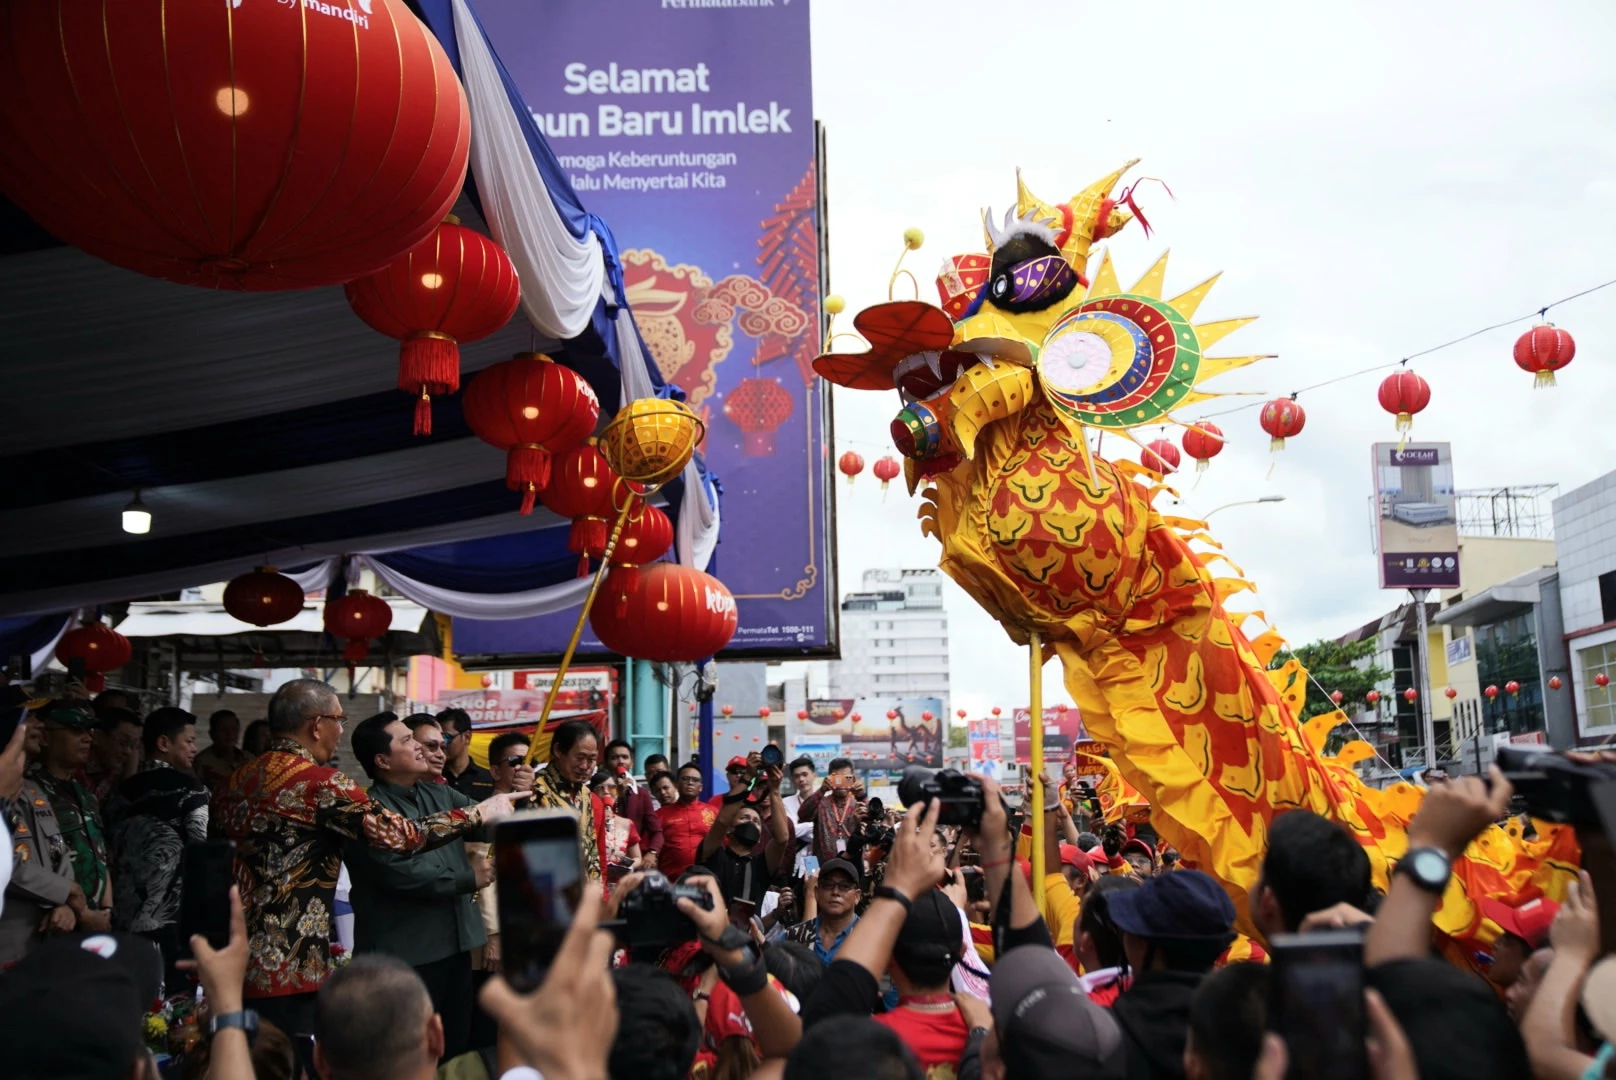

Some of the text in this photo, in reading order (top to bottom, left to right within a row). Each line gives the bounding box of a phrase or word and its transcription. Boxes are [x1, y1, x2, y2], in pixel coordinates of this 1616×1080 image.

[303, 0, 370, 30] mandiri
[563, 62, 710, 95] Selamat
[598, 103, 684, 137] Baru
[691, 101, 793, 136] Imlek
[556, 150, 737, 171] moga Keberuntungan
[602, 171, 688, 193] Menyertai
[691, 170, 727, 189] Kita
[737, 625, 815, 634] PermataTel 1500-111
[449, 699, 498, 709] SHOP
